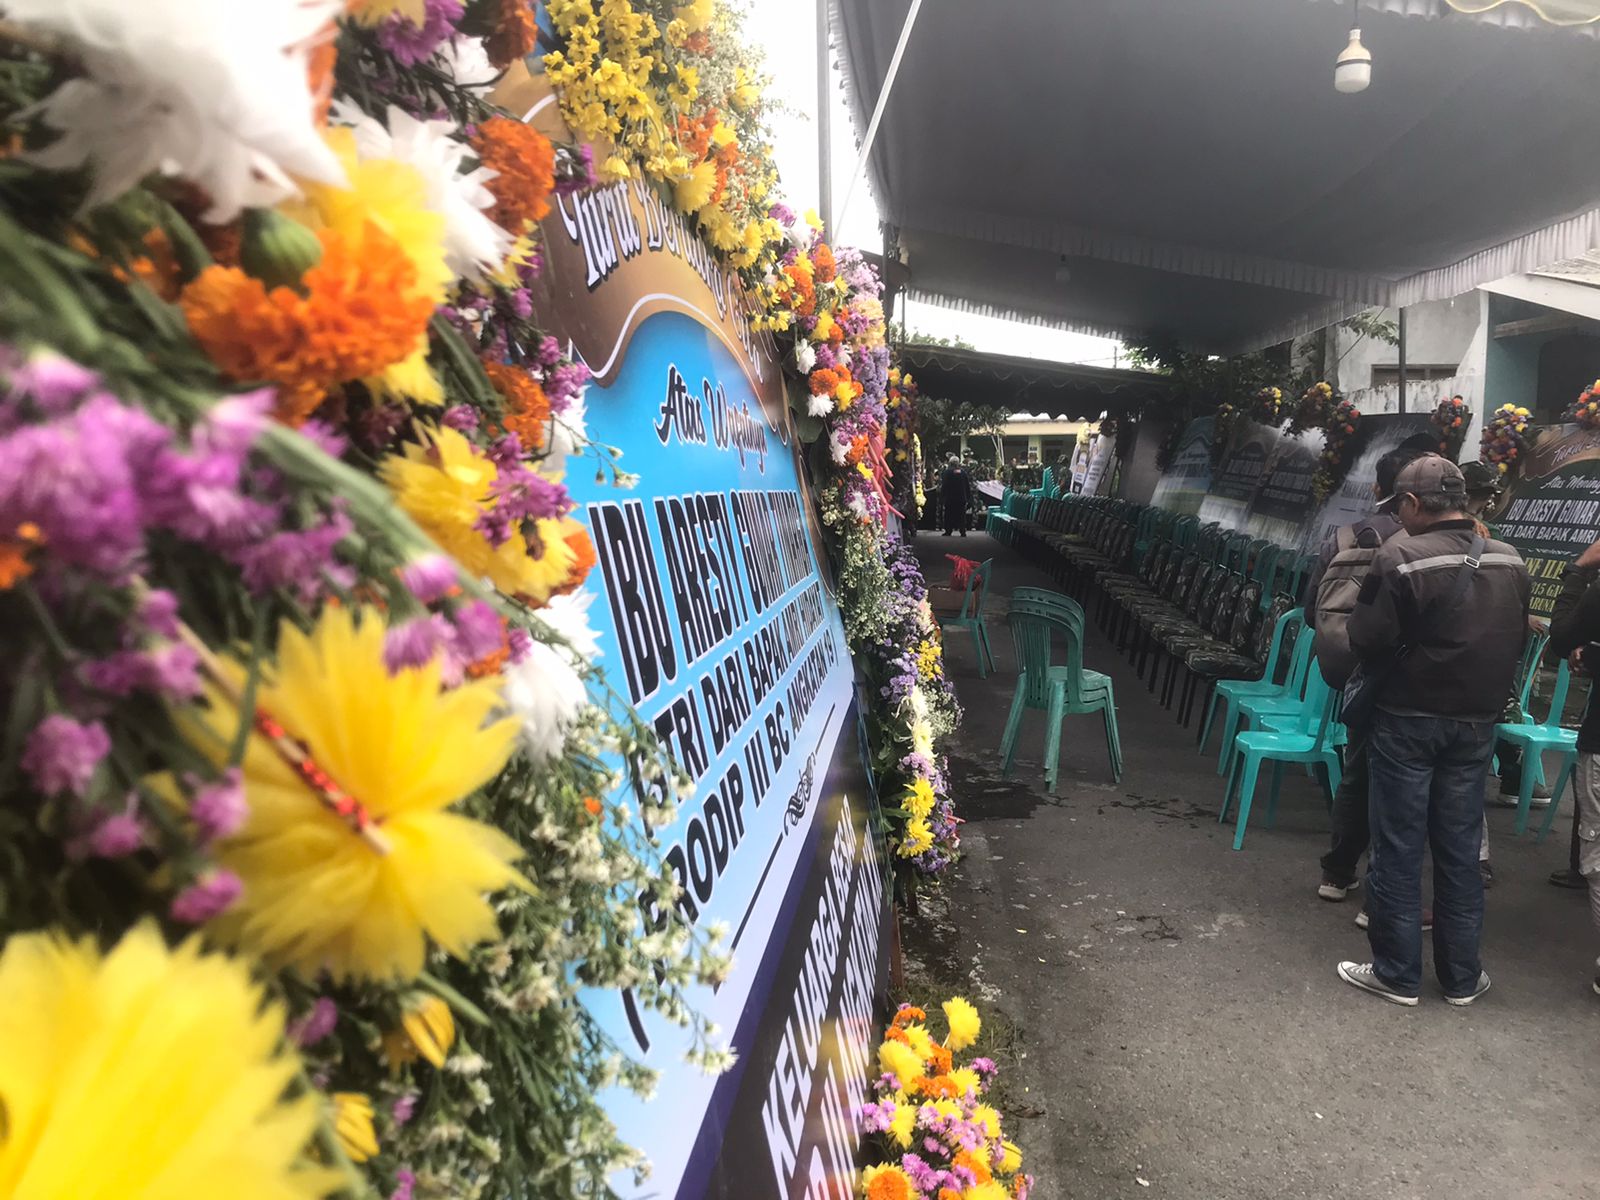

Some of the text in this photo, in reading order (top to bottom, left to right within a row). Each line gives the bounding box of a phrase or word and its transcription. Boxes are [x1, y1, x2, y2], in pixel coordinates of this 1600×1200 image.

[653, 362, 707, 447] Atas
[1495, 523, 1598, 544] STRI DARI BAPAK AMRI
[1506, 498, 1530, 521] IBU
[1522, 499, 1564, 523] ARESTY
[1557, 499, 1600, 525] GUNAR
[587, 498, 678, 708] IBU
[652, 490, 749, 668] ARESTY
[700, 649, 752, 758] DARI
[743, 615, 789, 707] BAPAK
[743, 729, 771, 808] III
[764, 700, 790, 775] BC
[786, 638, 829, 741] ANGKATAN
[762, 876, 842, 1200] KELUARGA
[830, 793, 857, 923] BESAR
[834, 857, 879, 1153] ANGKATAN
